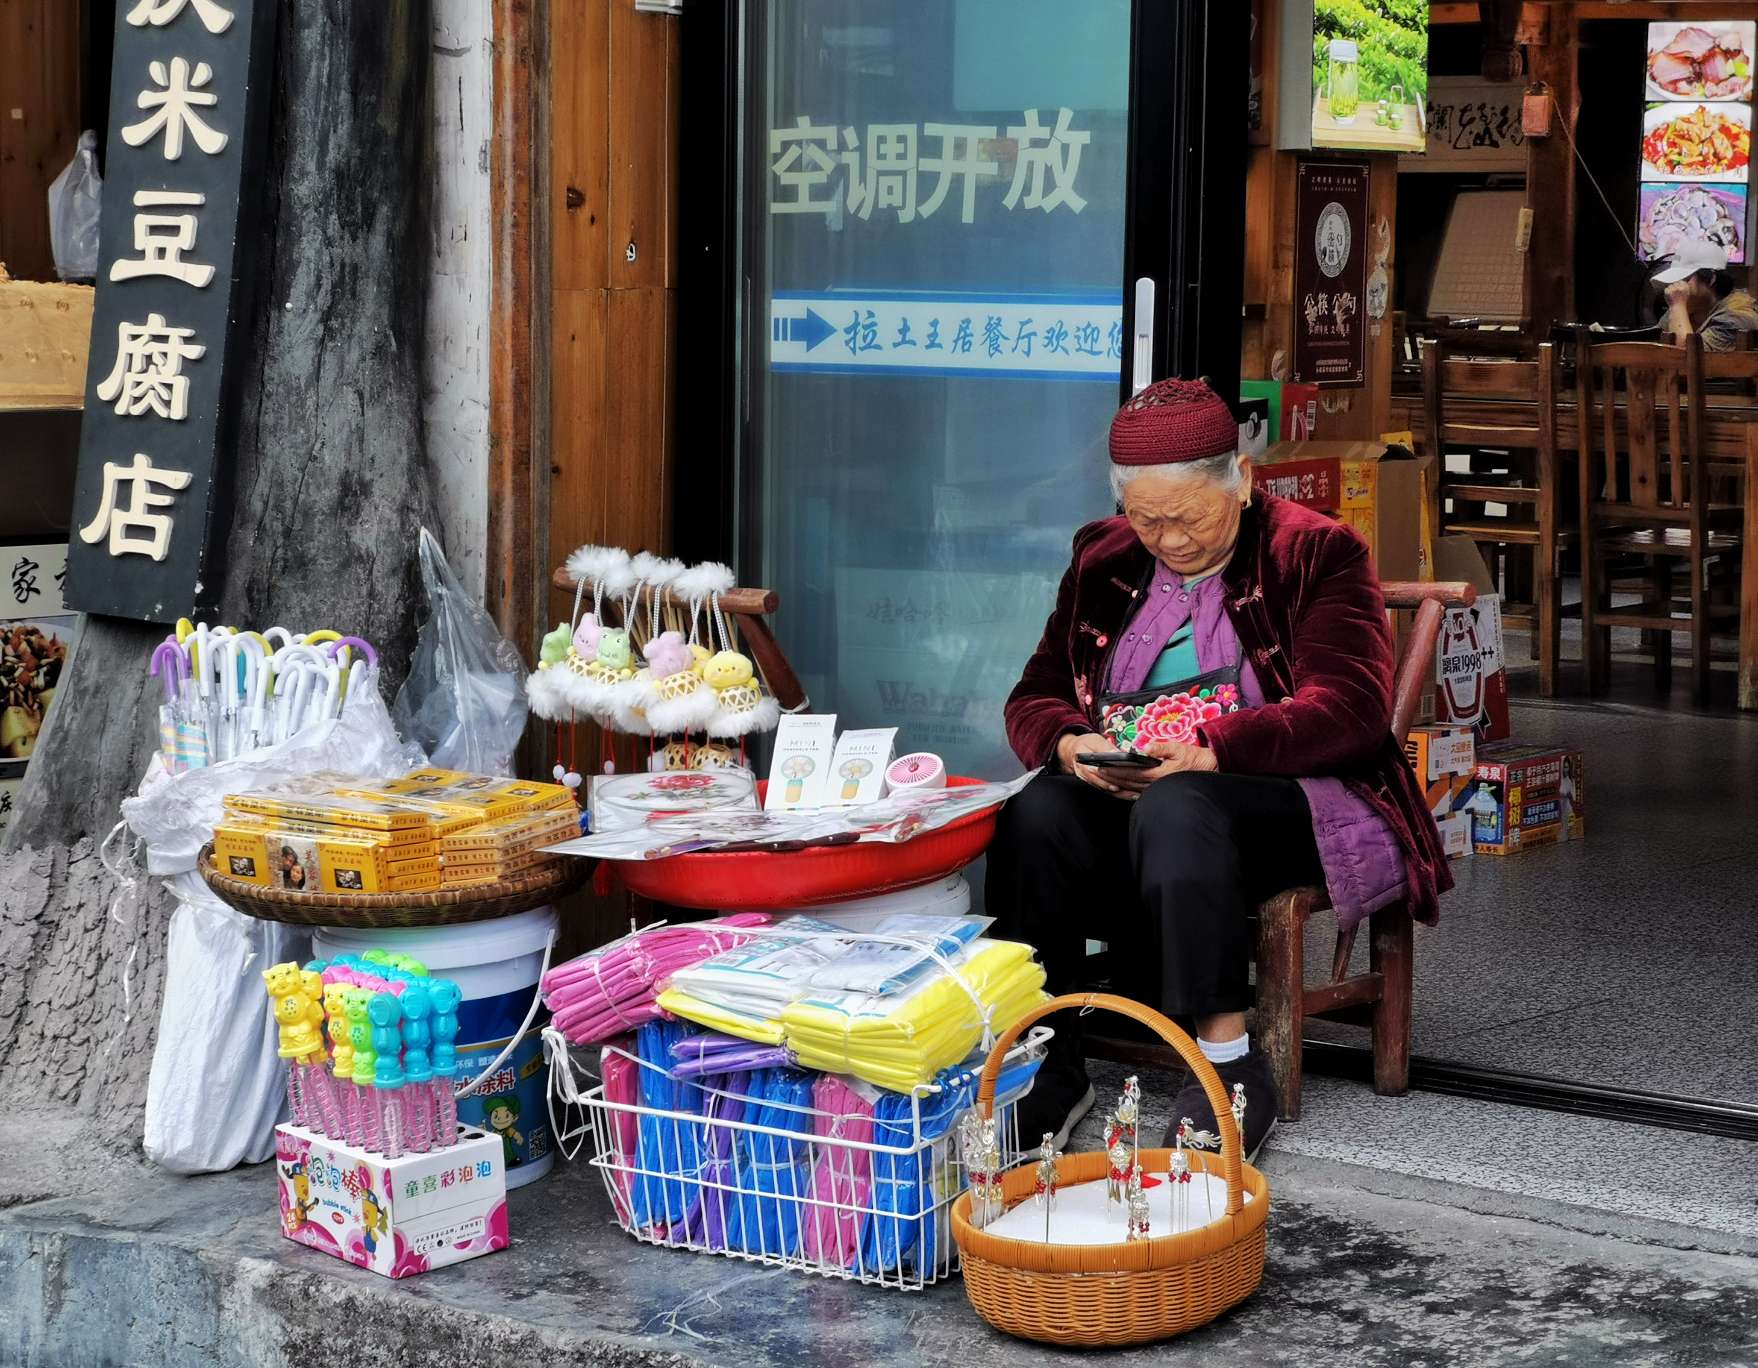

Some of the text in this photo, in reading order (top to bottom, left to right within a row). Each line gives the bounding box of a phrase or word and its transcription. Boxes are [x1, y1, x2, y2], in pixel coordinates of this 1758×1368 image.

[770, 107, 1091, 224] 空调开放
[405, 1160, 492, 1198] 童喜彩泡泡
